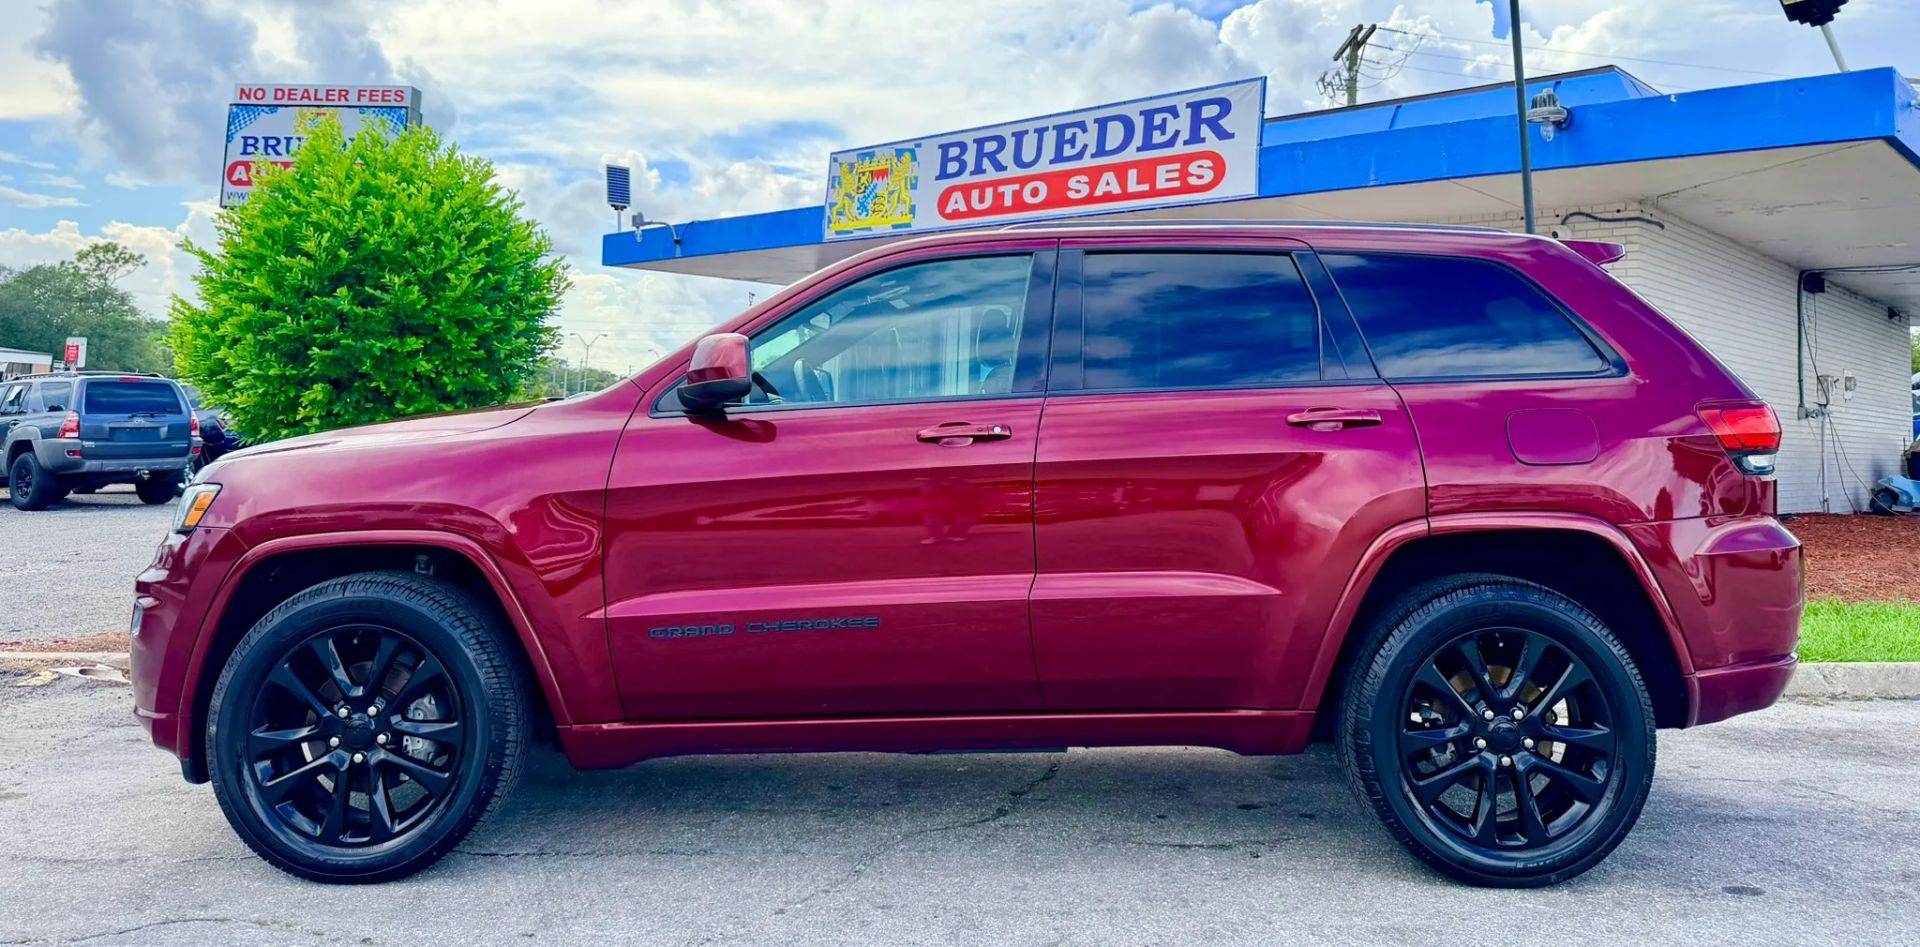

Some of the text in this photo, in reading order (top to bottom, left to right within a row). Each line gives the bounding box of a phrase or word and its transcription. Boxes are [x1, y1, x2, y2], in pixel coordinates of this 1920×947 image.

[239, 87, 405, 103] NO DEALER FEES
[935, 97, 1235, 181] BRUEDER
[944, 158, 1215, 213] AUTO SALES
[648, 617, 881, 639] GRAND CHEROKEE
